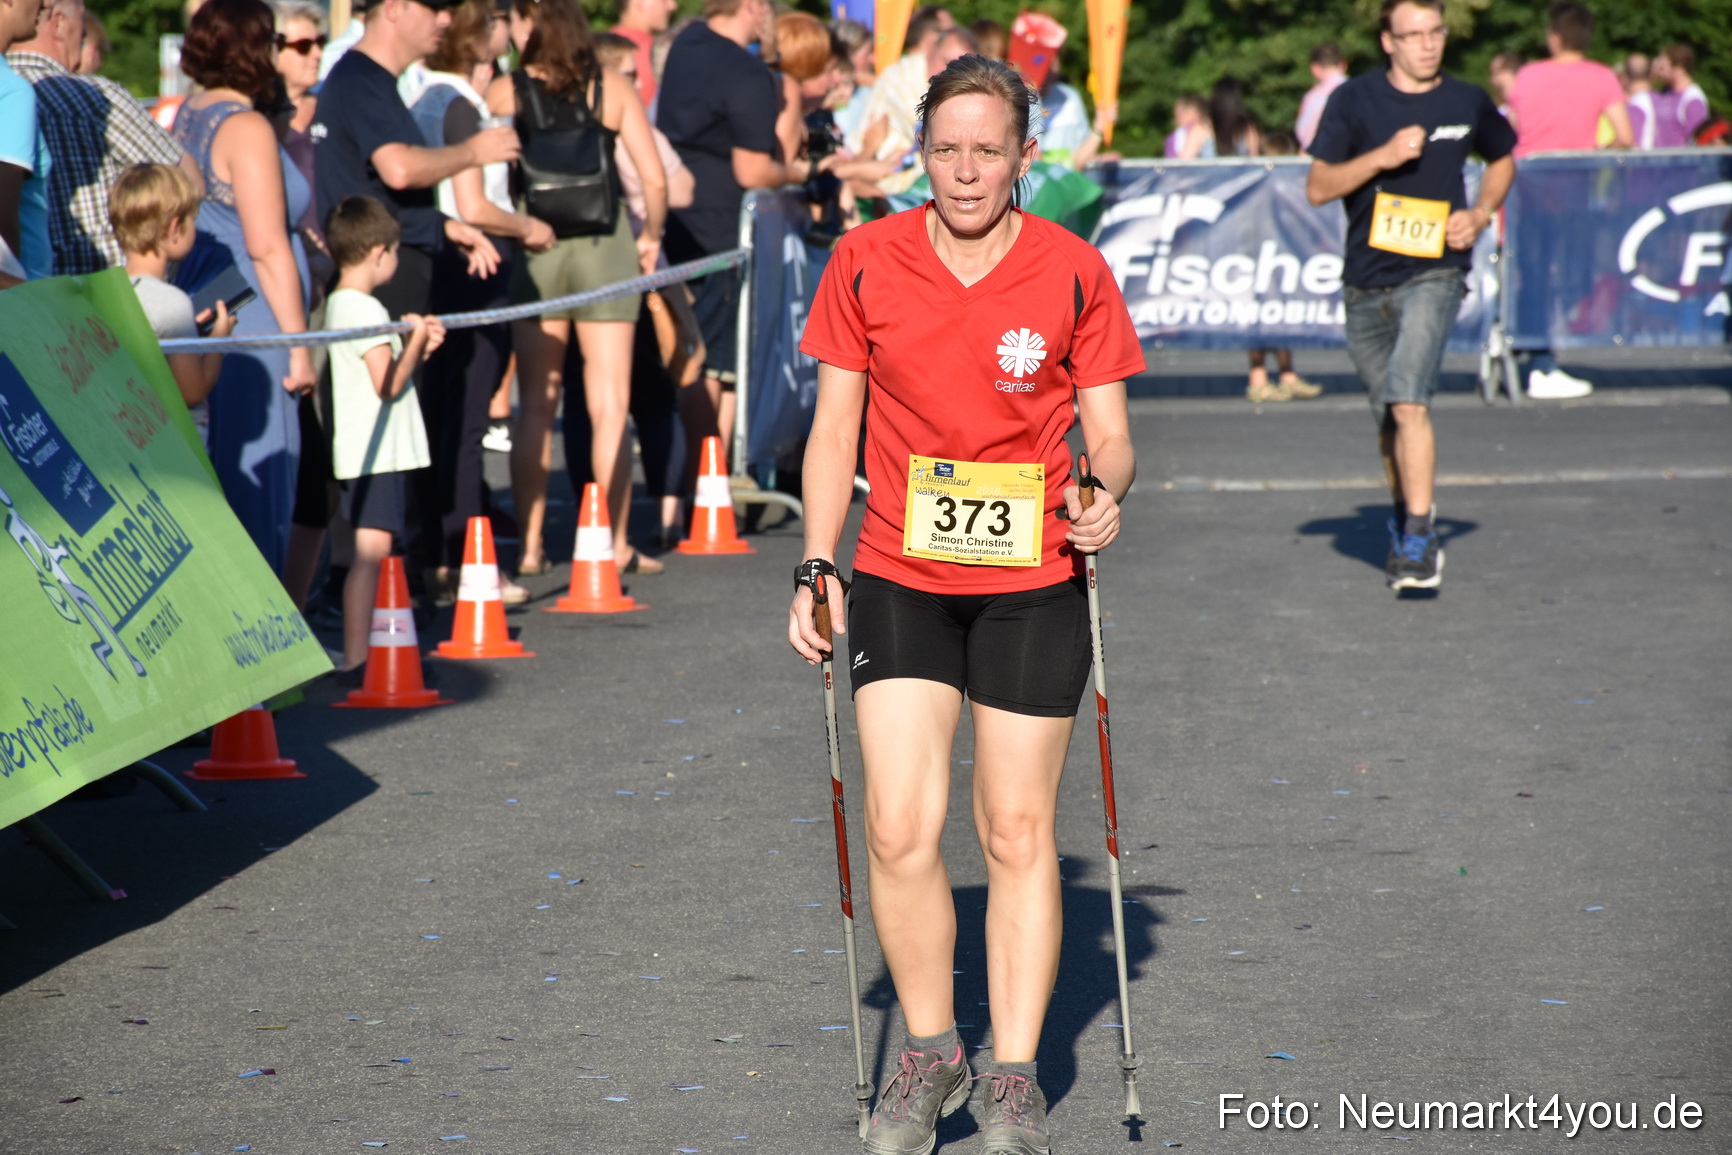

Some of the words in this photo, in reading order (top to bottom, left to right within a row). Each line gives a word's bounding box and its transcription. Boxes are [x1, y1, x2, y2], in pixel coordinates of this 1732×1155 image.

[1384, 215, 1436, 241] 1107
[8, 411, 48, 454] Fischer
[925, 473, 972, 487] firmenlauf
[934, 496, 1011, 536] 373
[928, 543, 999, 556] Caritas-Sozialstation
[931, 532, 963, 545] Simon
[966, 536, 1014, 548] Christine
[135, 594, 183, 662] neumarkt
